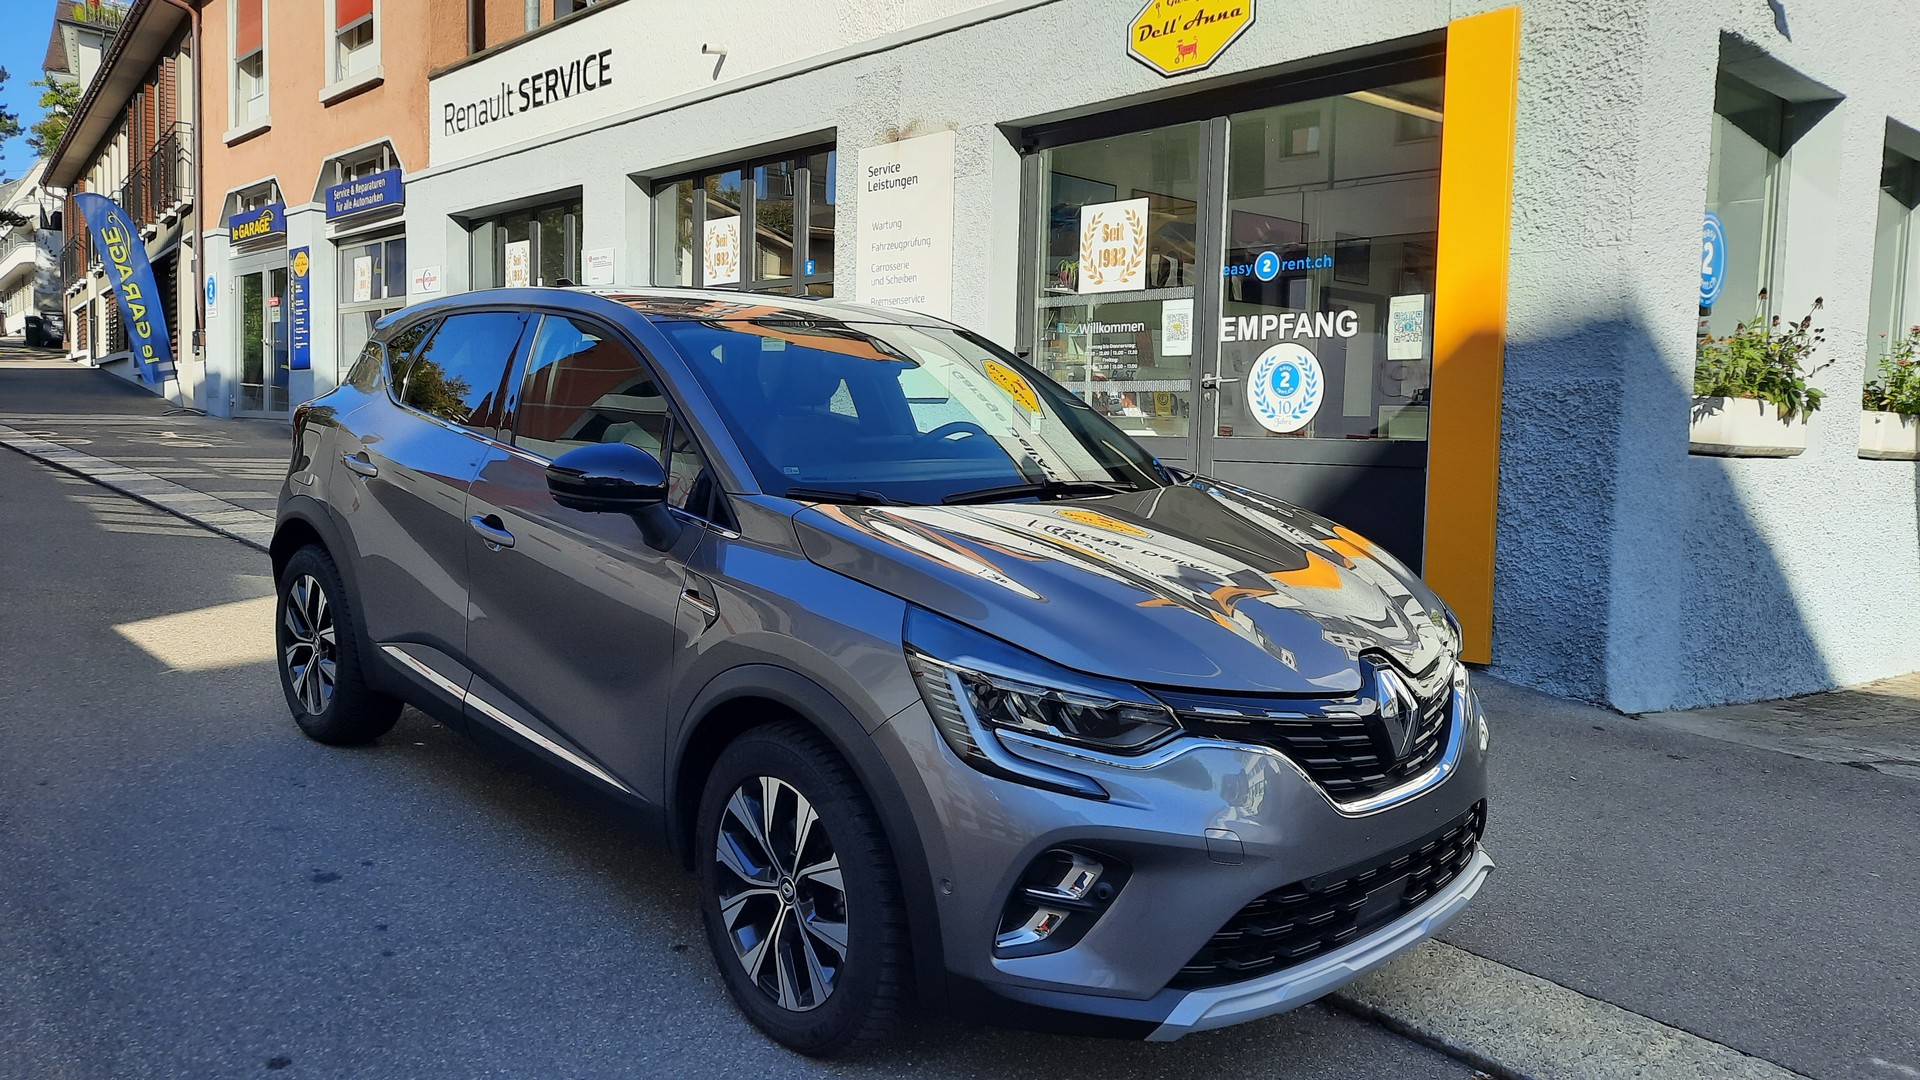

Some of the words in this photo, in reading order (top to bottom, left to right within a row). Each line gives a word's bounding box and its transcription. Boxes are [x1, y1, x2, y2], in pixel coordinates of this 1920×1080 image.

[444, 82, 514, 136] Renault
[518, 48, 612, 113] SERVICE
[867, 162, 901, 179] Service
[333, 188, 350, 200] Service
[350, 185, 355, 195] &
[355, 178, 386, 194] Reparaturen
[867, 174, 918, 192] Leistungen
[335, 201, 343, 212] für
[344, 199, 352, 211] alle
[353, 192, 384, 208] Automarken
[232, 226, 239, 240] le
[239, 217, 270, 239] GARAGE
[871, 219, 902, 232] Wartung
[1101, 222, 1125, 243] Seit
[871, 236, 931, 252] Fahrzeugprüfung
[1223, 263, 1253, 277] easy
[1262, 259, 1272, 273] 2
[1282, 254, 1333, 271] rent.ch
[1702, 241, 1714, 275] 2
[870, 260, 910, 274] Carrosserie
[870, 276, 885, 287] und
[885, 273, 917, 286] Scheiben
[870, 293, 925, 306] Bremsenservice
[1080, 322, 1145, 334] Willkommen
[1220, 309, 1359, 342] EMPFANG
[1280, 371, 1291, 388] 2
[1278, 400, 1292, 415] 10
